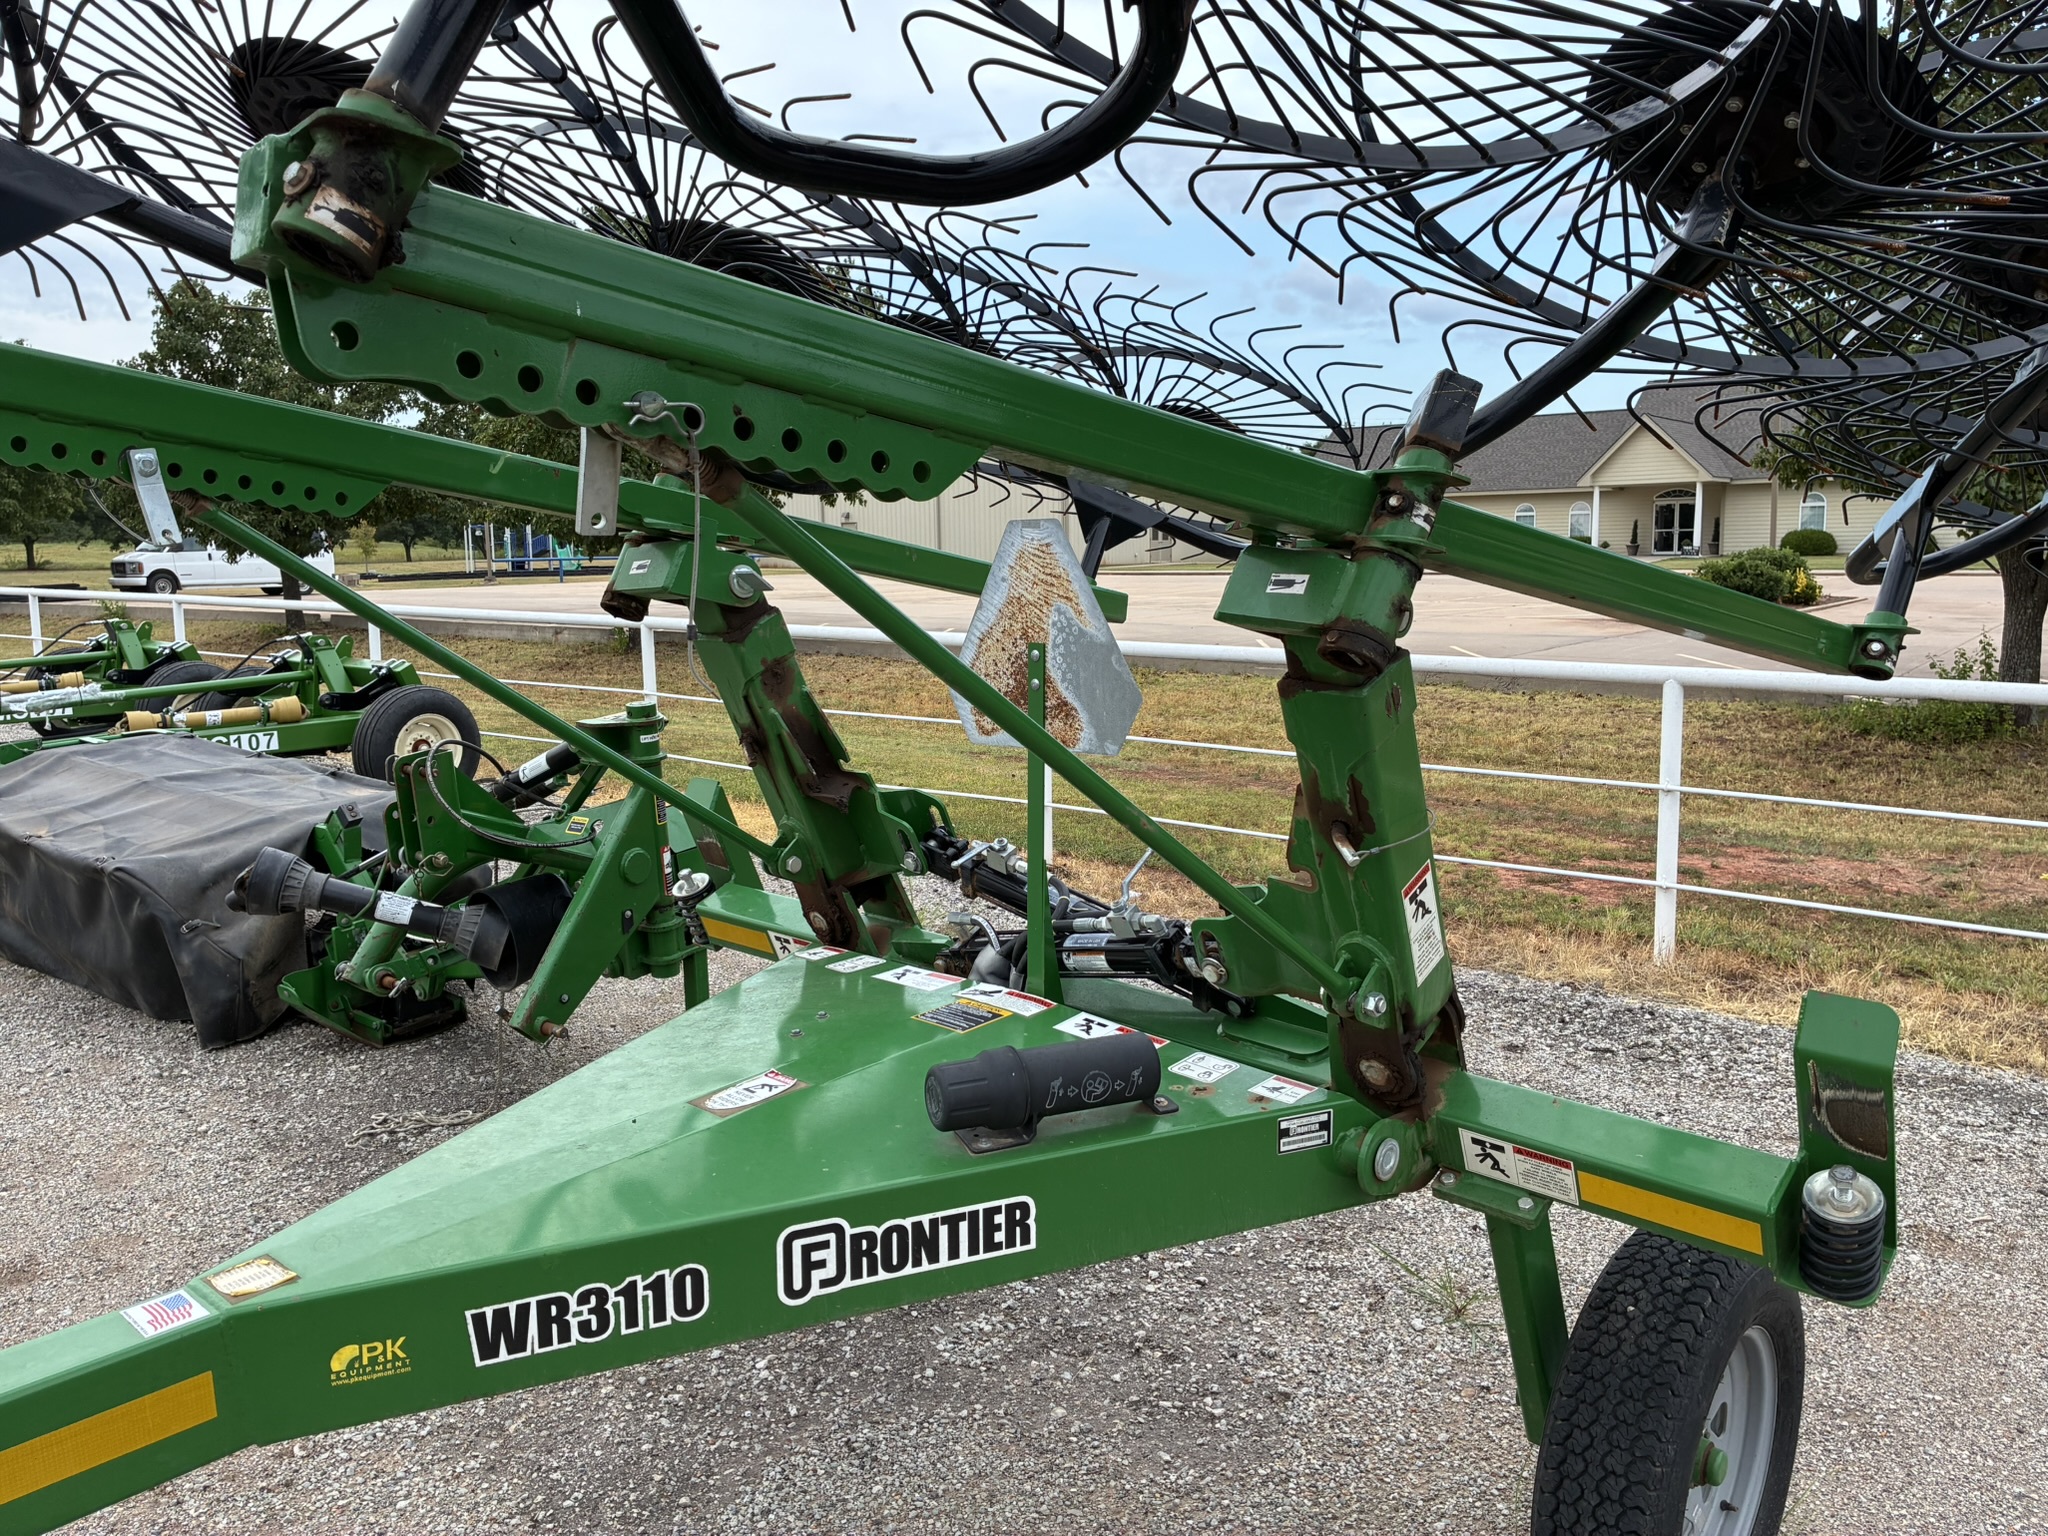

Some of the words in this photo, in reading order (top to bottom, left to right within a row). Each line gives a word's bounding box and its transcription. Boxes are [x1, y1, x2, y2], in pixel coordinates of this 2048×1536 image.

[1524, 1150, 1570, 1168] WARNING
[781, 1199, 1032, 1301] FRONTIER
[469, 1266, 706, 1364] WR3110
[361, 1336, 407, 1365] P&K
[330, 1359, 411, 1380] EQUIPMENT
[331, 1366, 412, 1387] www.pkequipment.com
